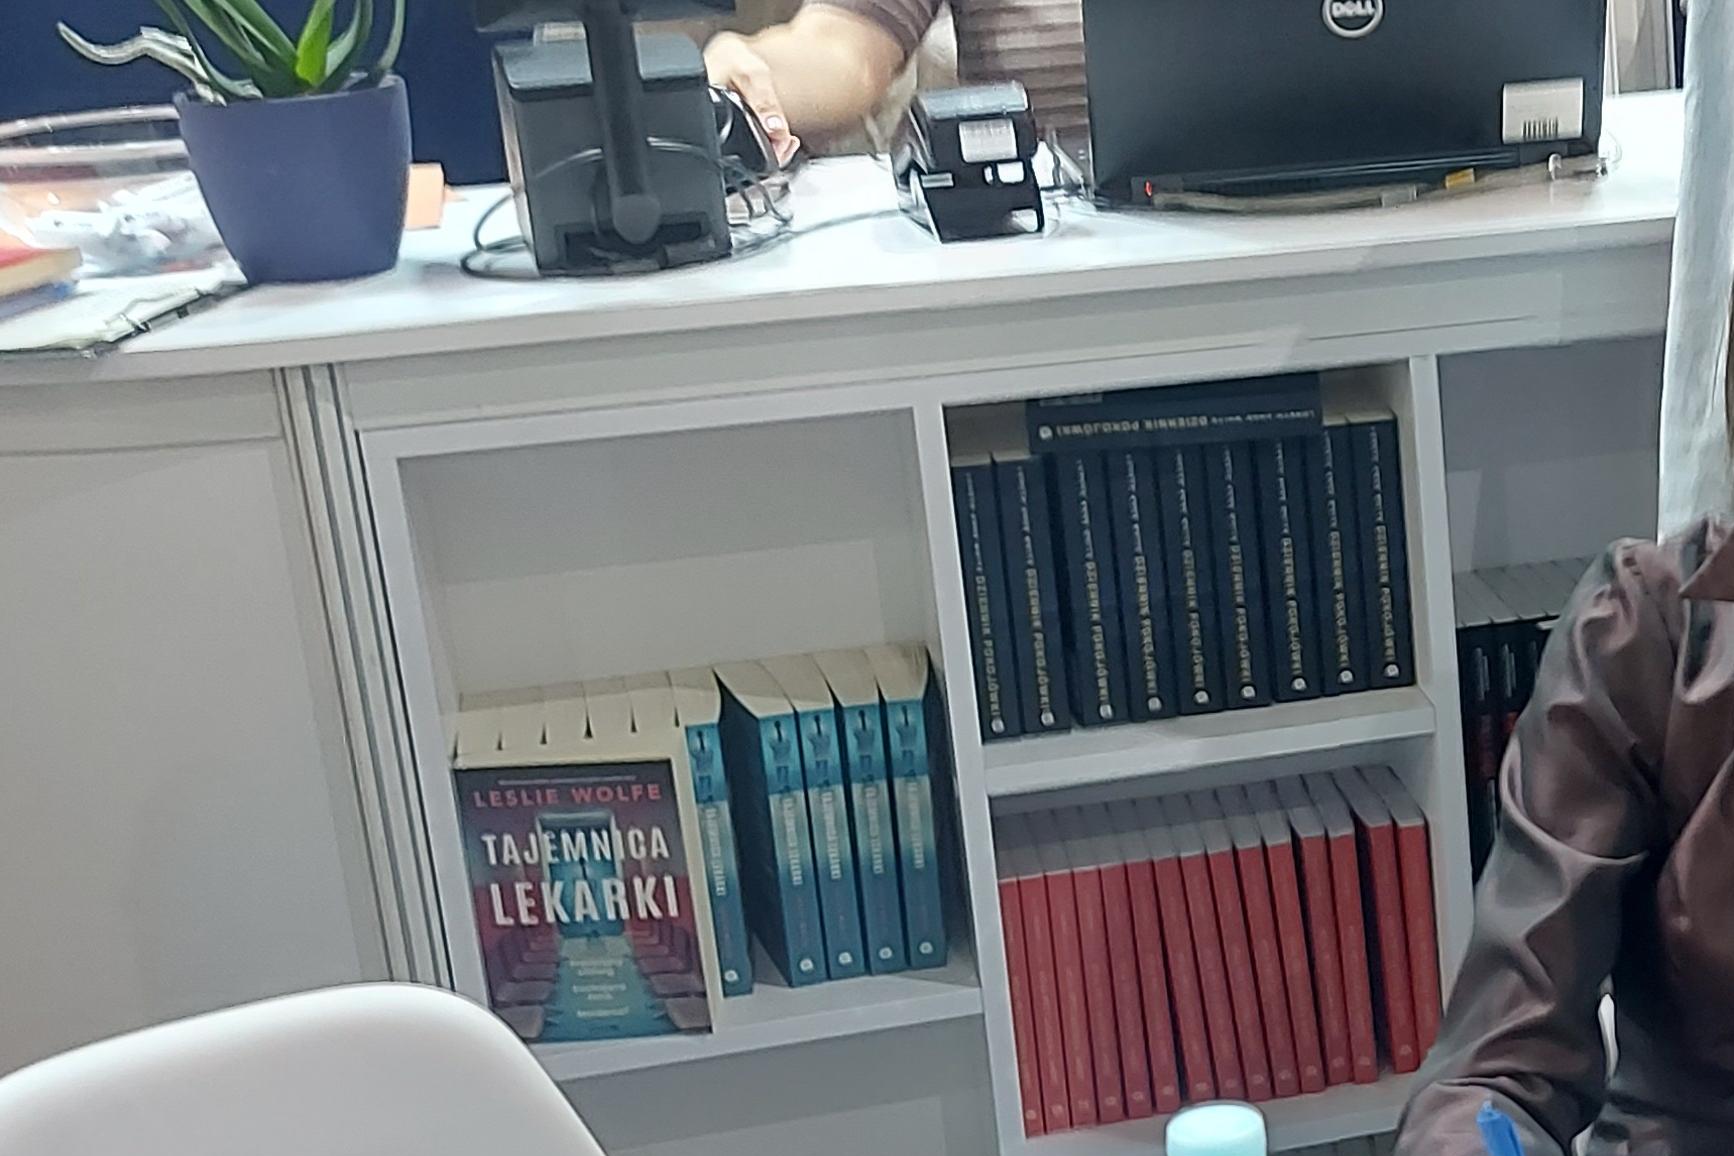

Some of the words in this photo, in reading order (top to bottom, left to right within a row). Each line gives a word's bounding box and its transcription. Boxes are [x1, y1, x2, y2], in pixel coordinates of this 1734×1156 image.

[474, 788, 560, 808] LESLIE
[571, 783, 662, 804] WOLFE
[481, 825, 671, 867] TAJEMNICA
[489, 874, 680, 927] LEKARKI
